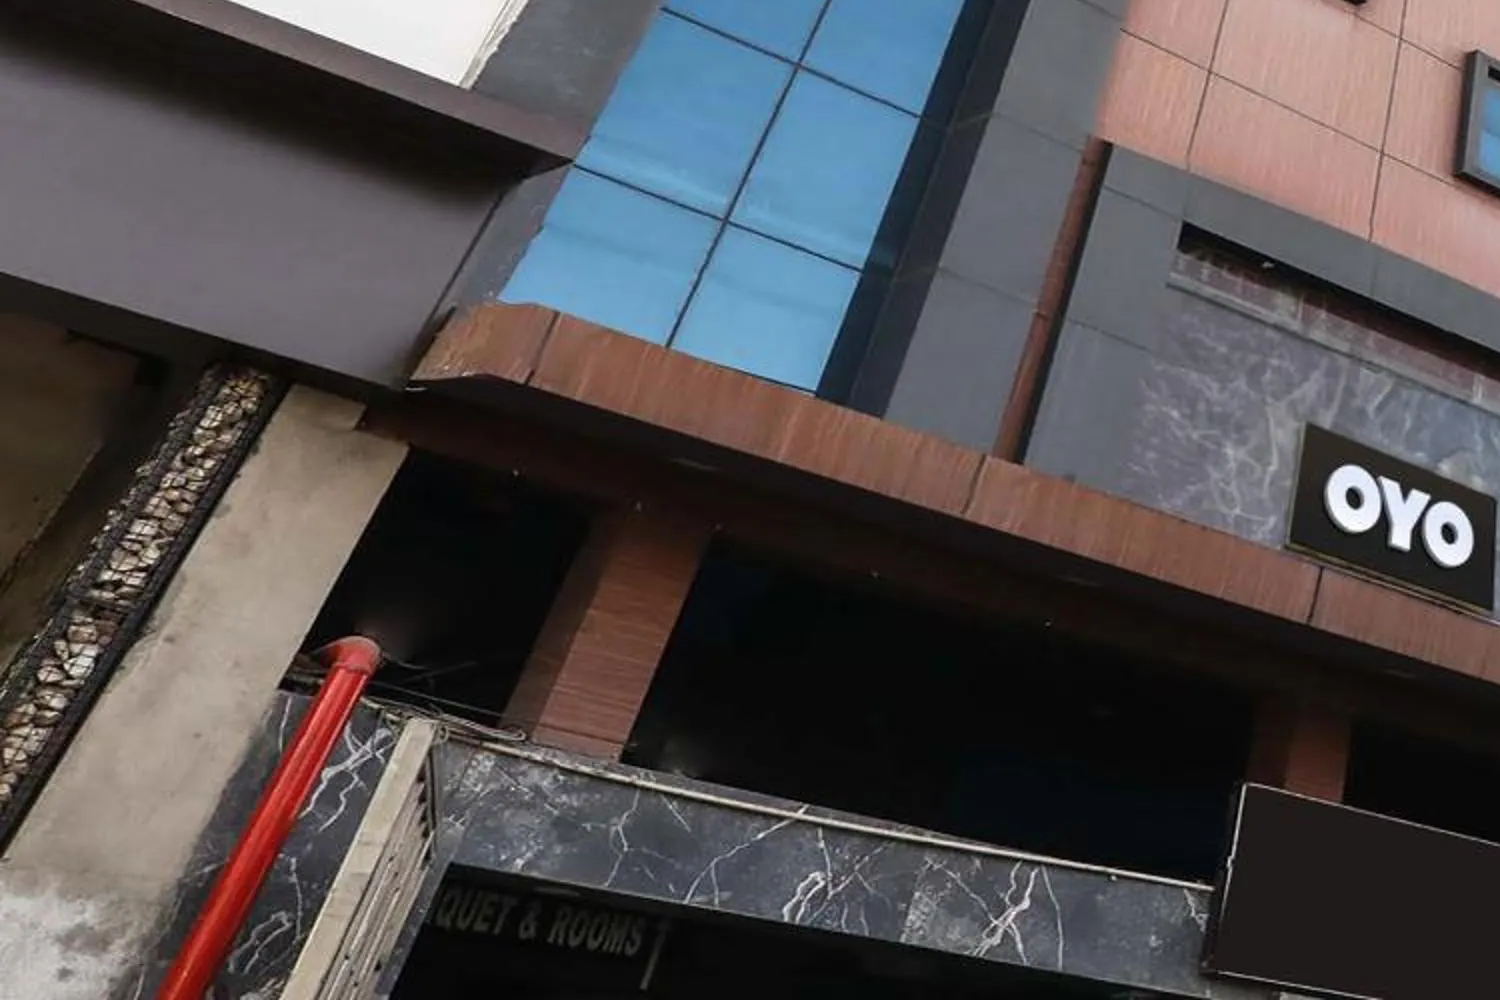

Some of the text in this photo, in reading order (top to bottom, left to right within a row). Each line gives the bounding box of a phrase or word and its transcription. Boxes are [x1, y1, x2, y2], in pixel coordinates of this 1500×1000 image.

[1324, 464, 1475, 569] OYO
[427, 886, 645, 957] QUET & ROOMS
